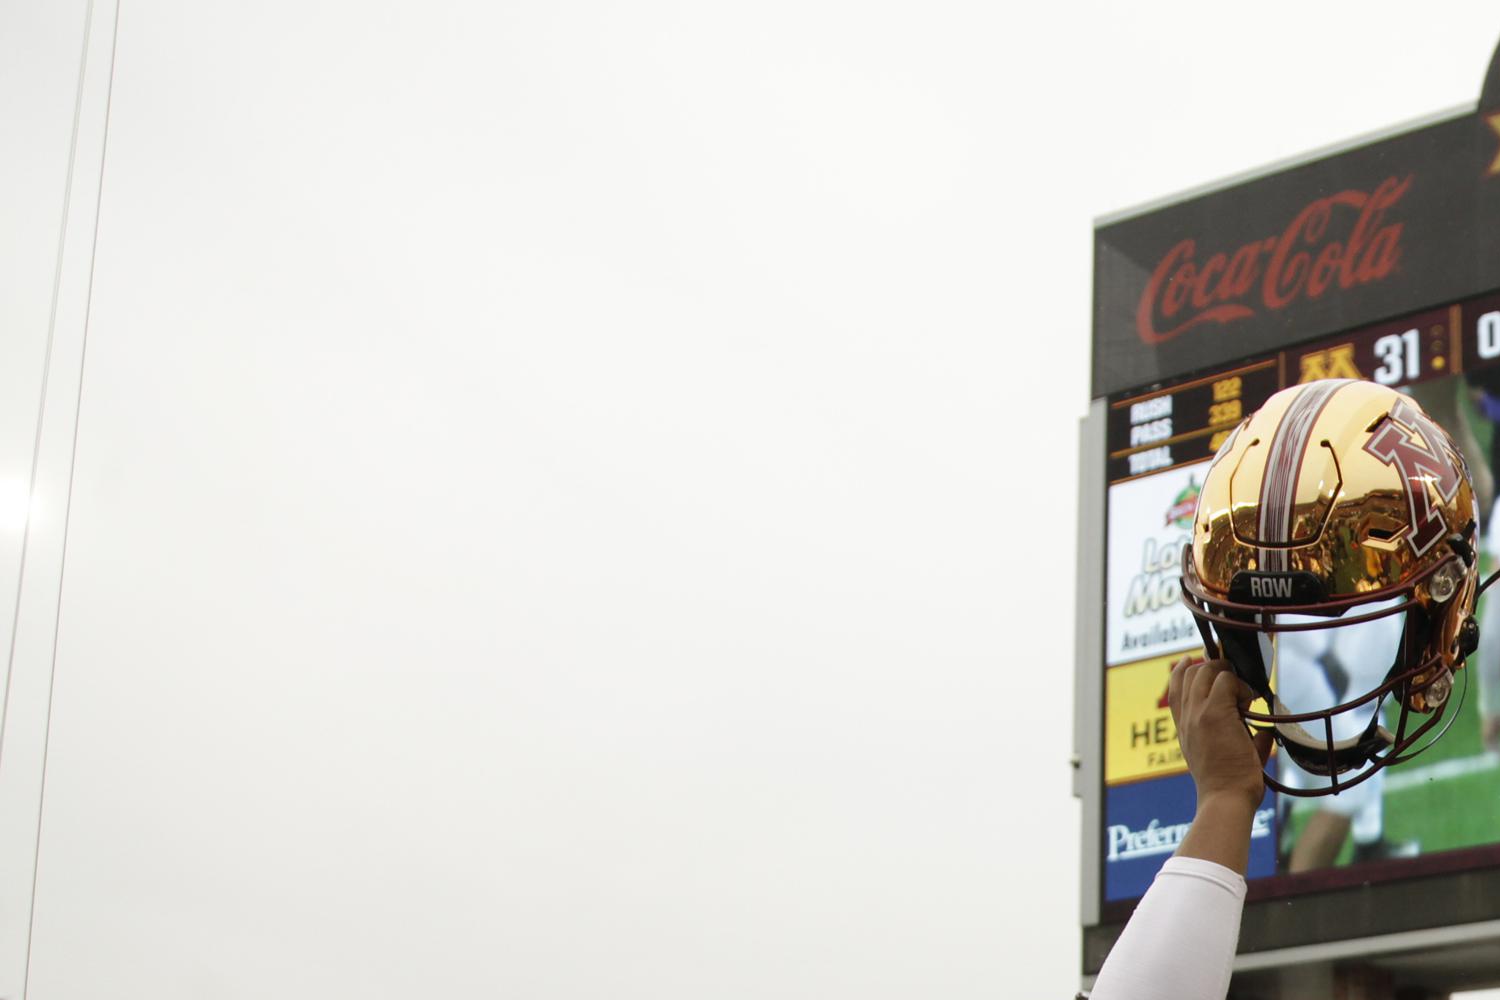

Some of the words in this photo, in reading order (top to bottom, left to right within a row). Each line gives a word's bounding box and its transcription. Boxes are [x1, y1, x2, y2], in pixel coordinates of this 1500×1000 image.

[1136, 174, 1412, 345] Coca-Cola
[1374, 328, 1421, 386] 31
[1130, 395, 1173, 426] RUSH
[1130, 417, 1173, 448] PASS
[1127, 445, 1173, 475] TOTAL
[1250, 577, 1293, 598] ROW
